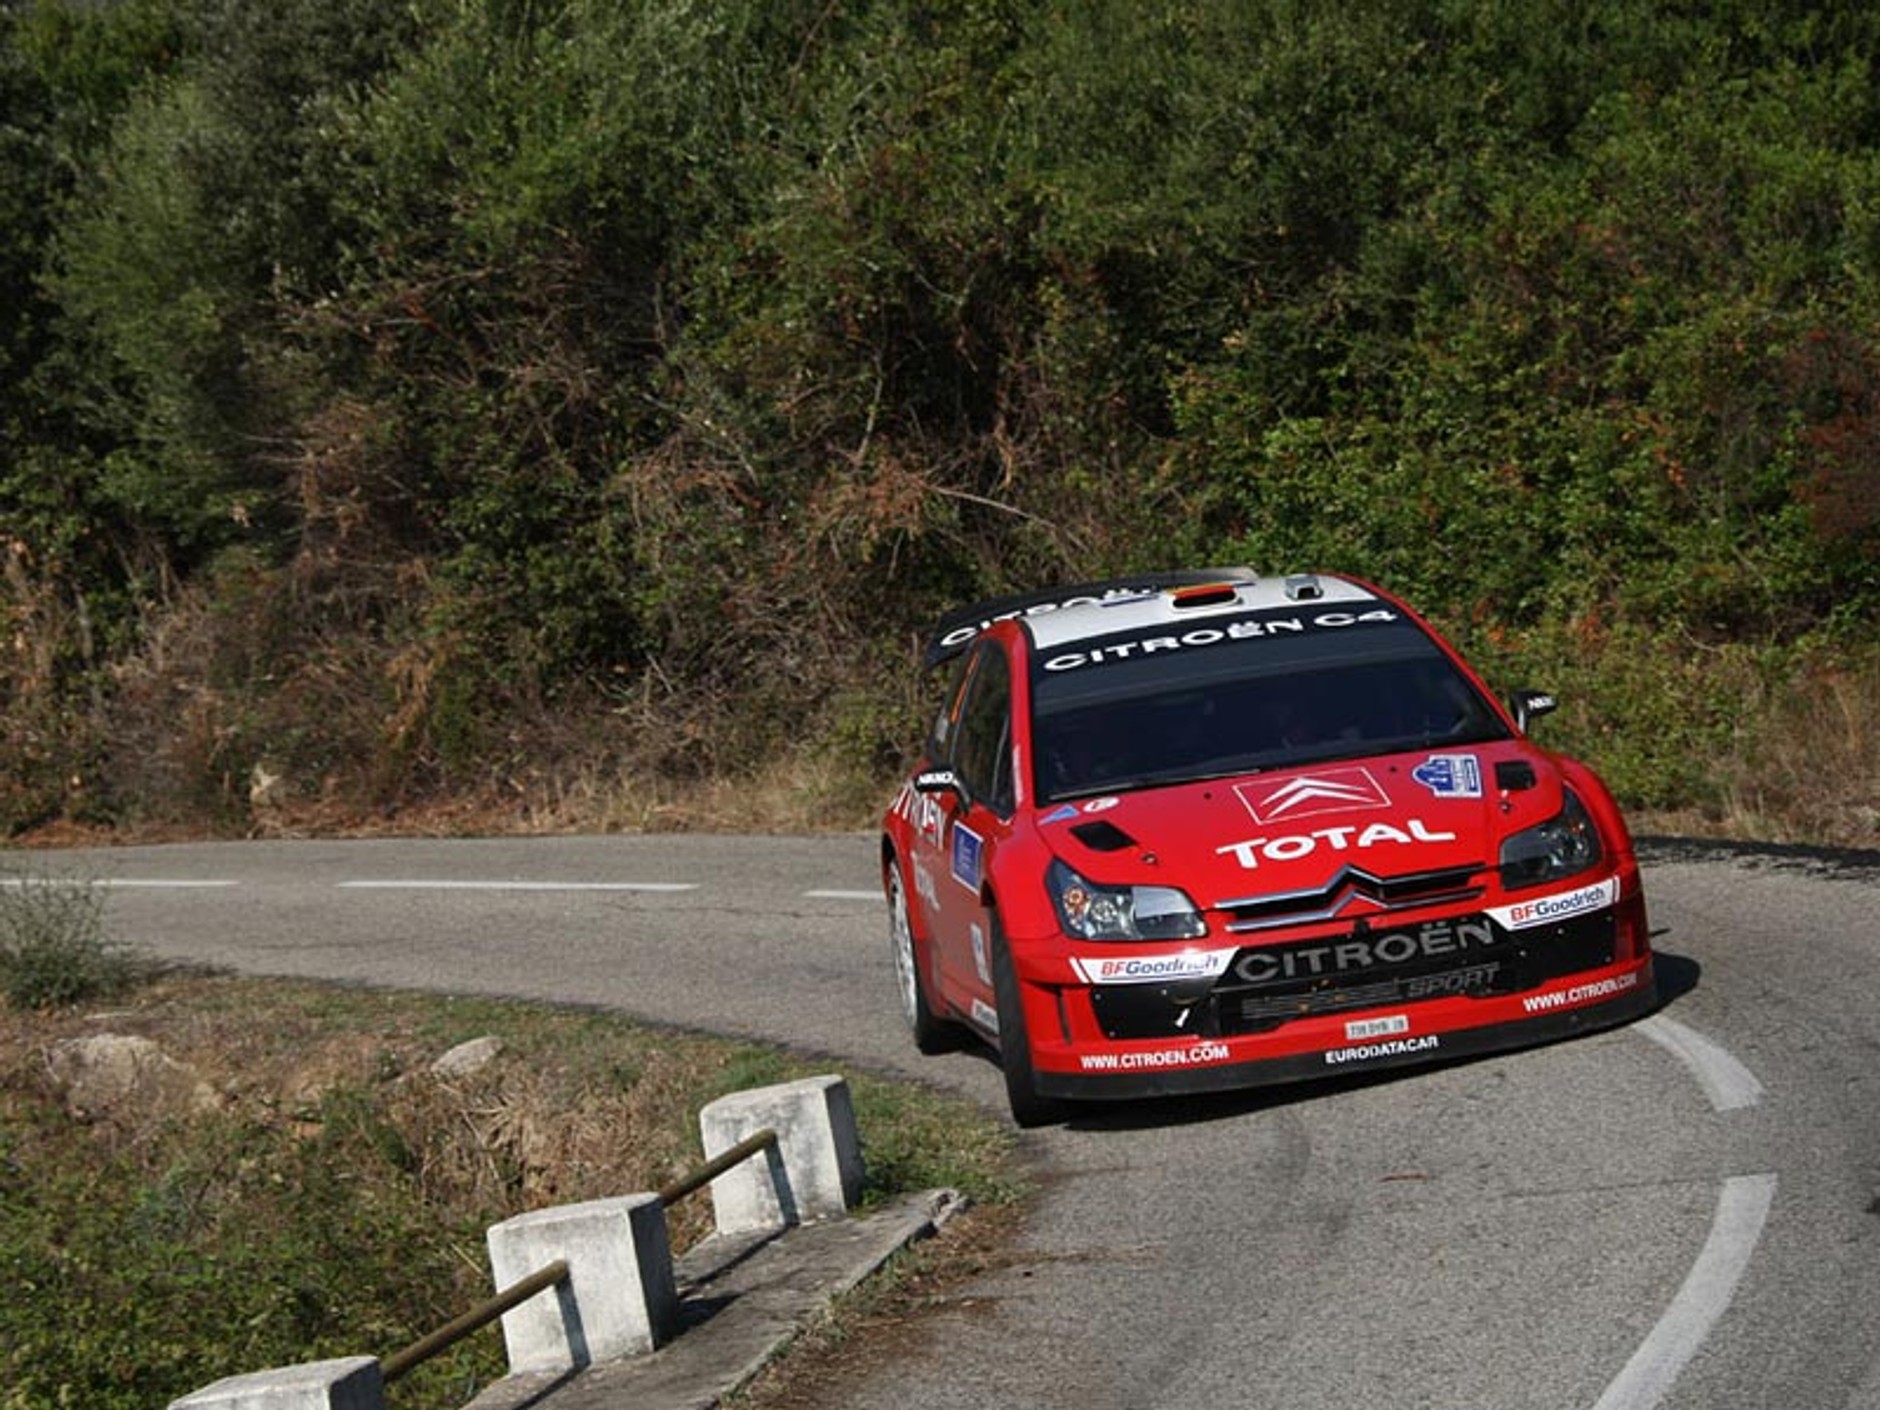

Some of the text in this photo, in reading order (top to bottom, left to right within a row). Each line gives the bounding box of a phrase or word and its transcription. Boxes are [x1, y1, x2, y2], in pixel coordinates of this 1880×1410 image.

[1314, 610, 1397, 627] C4
[1214, 820, 1456, 869] TOTAL
[1510, 886, 1605, 923] BFGoodrich
[1235, 919, 1495, 982] CITROËN
[1407, 961, 1500, 998] SPORT
[1081, 1045, 1229, 1069] WWW.CITROEN.COM
[1325, 1034, 1439, 1064] EURODATACAR
